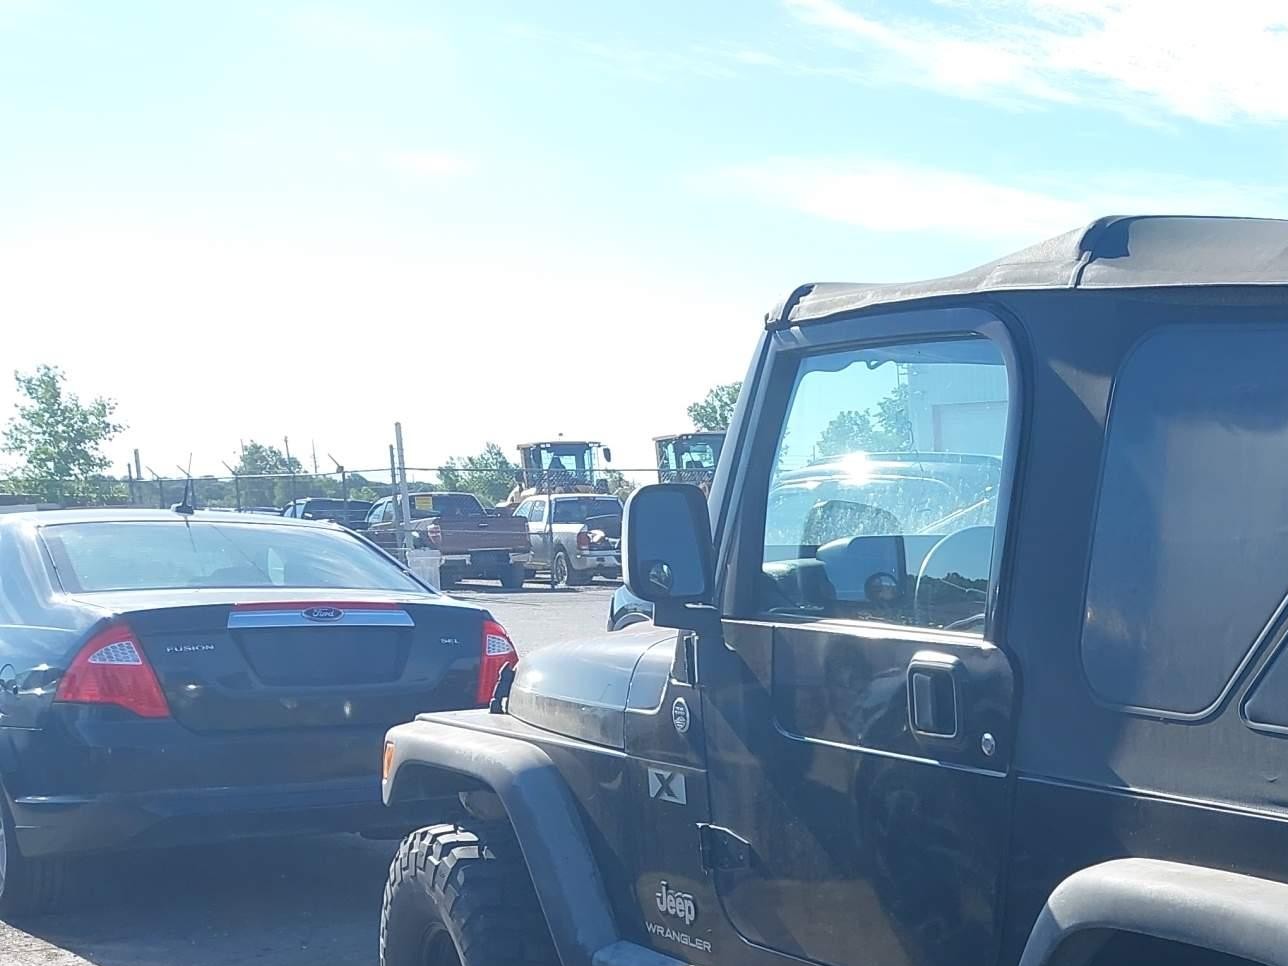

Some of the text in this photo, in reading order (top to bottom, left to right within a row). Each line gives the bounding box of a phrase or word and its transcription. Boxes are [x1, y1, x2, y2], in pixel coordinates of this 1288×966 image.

[311, 607, 337, 619] Ford
[166, 644, 214, 653] FUSION
[441, 637, 459, 645] SEL
[655, 772, 680, 799] X
[656, 880, 695, 925] Jeep
[646, 921, 712, 952] WRANGLER
